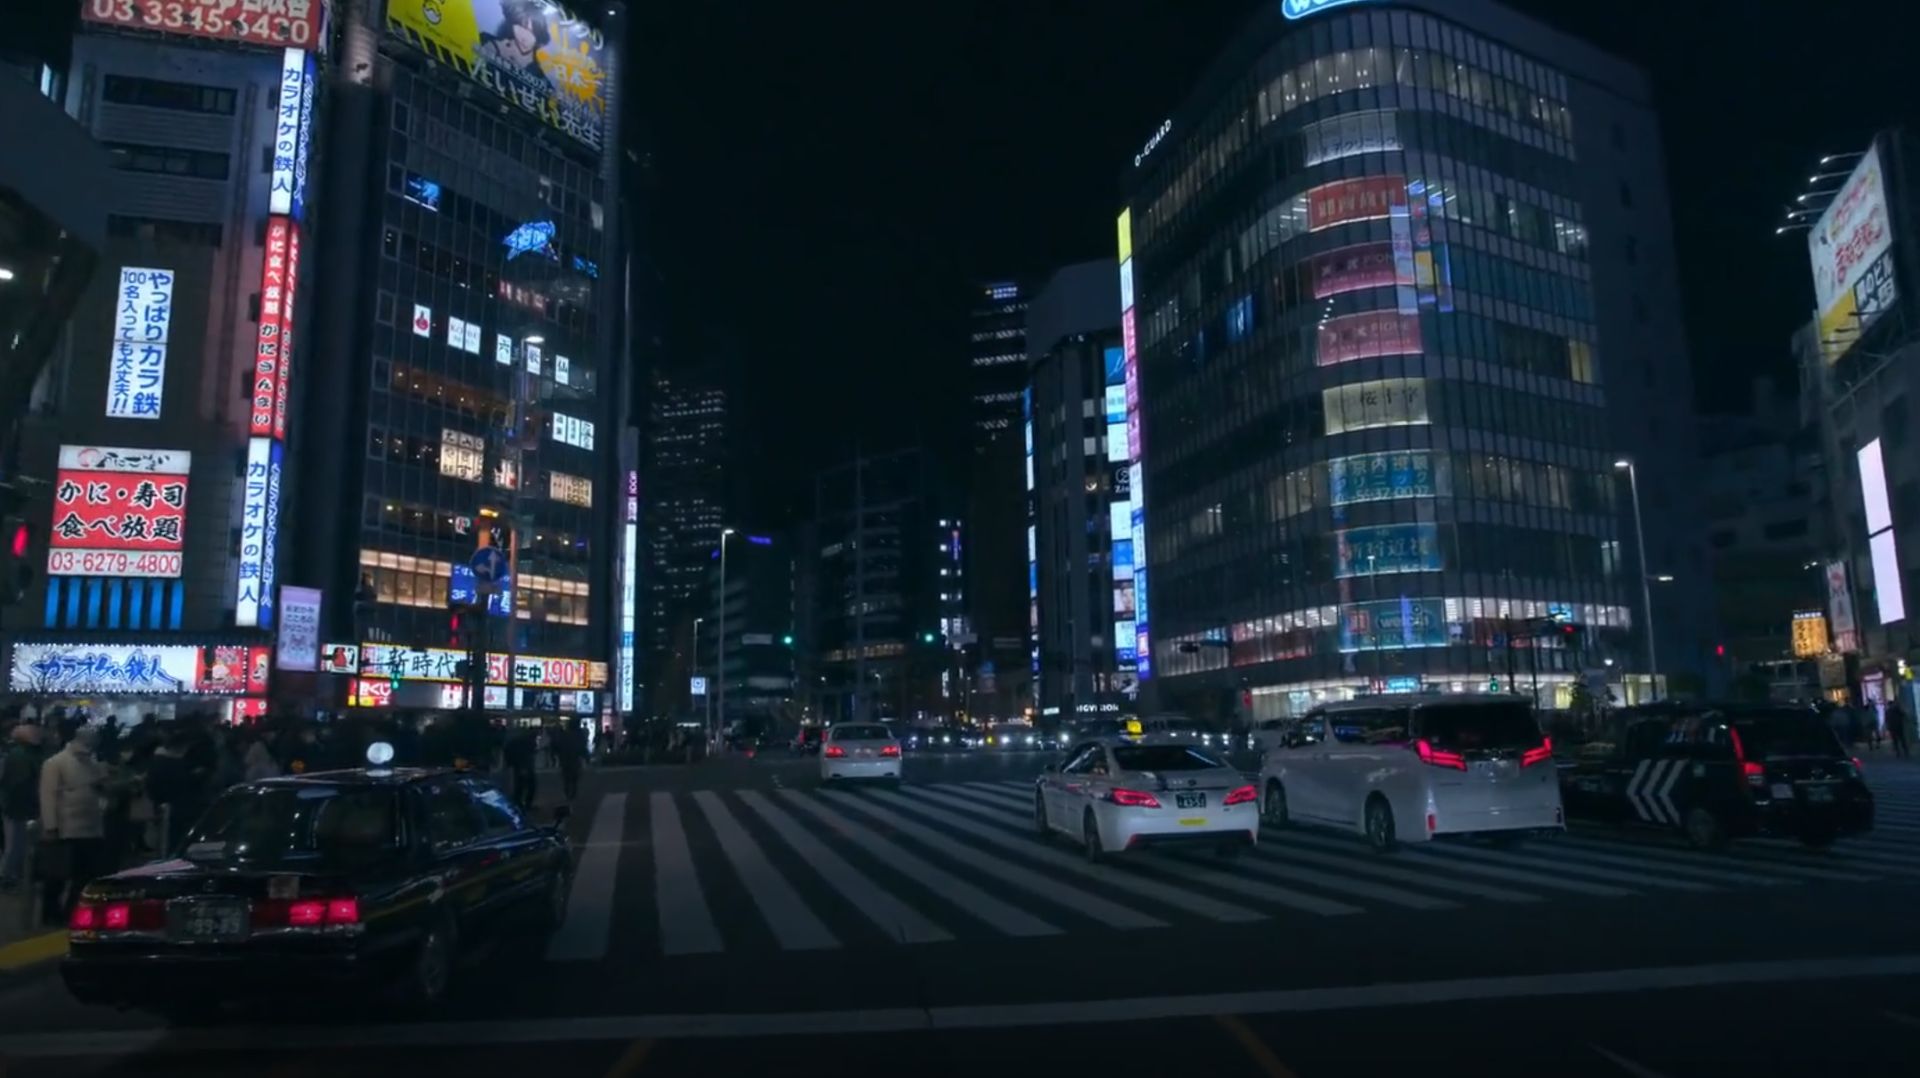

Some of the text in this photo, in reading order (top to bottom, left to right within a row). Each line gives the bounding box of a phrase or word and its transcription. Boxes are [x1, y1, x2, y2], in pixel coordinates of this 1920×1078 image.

[272, 66, 302, 194] カラオケの鉄人
[1135, 119, 1171, 167] O-GUARD
[57, 481, 185, 508] かに・寿司
[55, 512, 182, 543] 食べ放題
[239, 461, 266, 603] カラオケの鉄人
[51, 552, 181, 573] 03-6279-4800
[33, 651, 179, 685] カラオケの鉄人
[389, 648, 459, 679] 新時代
